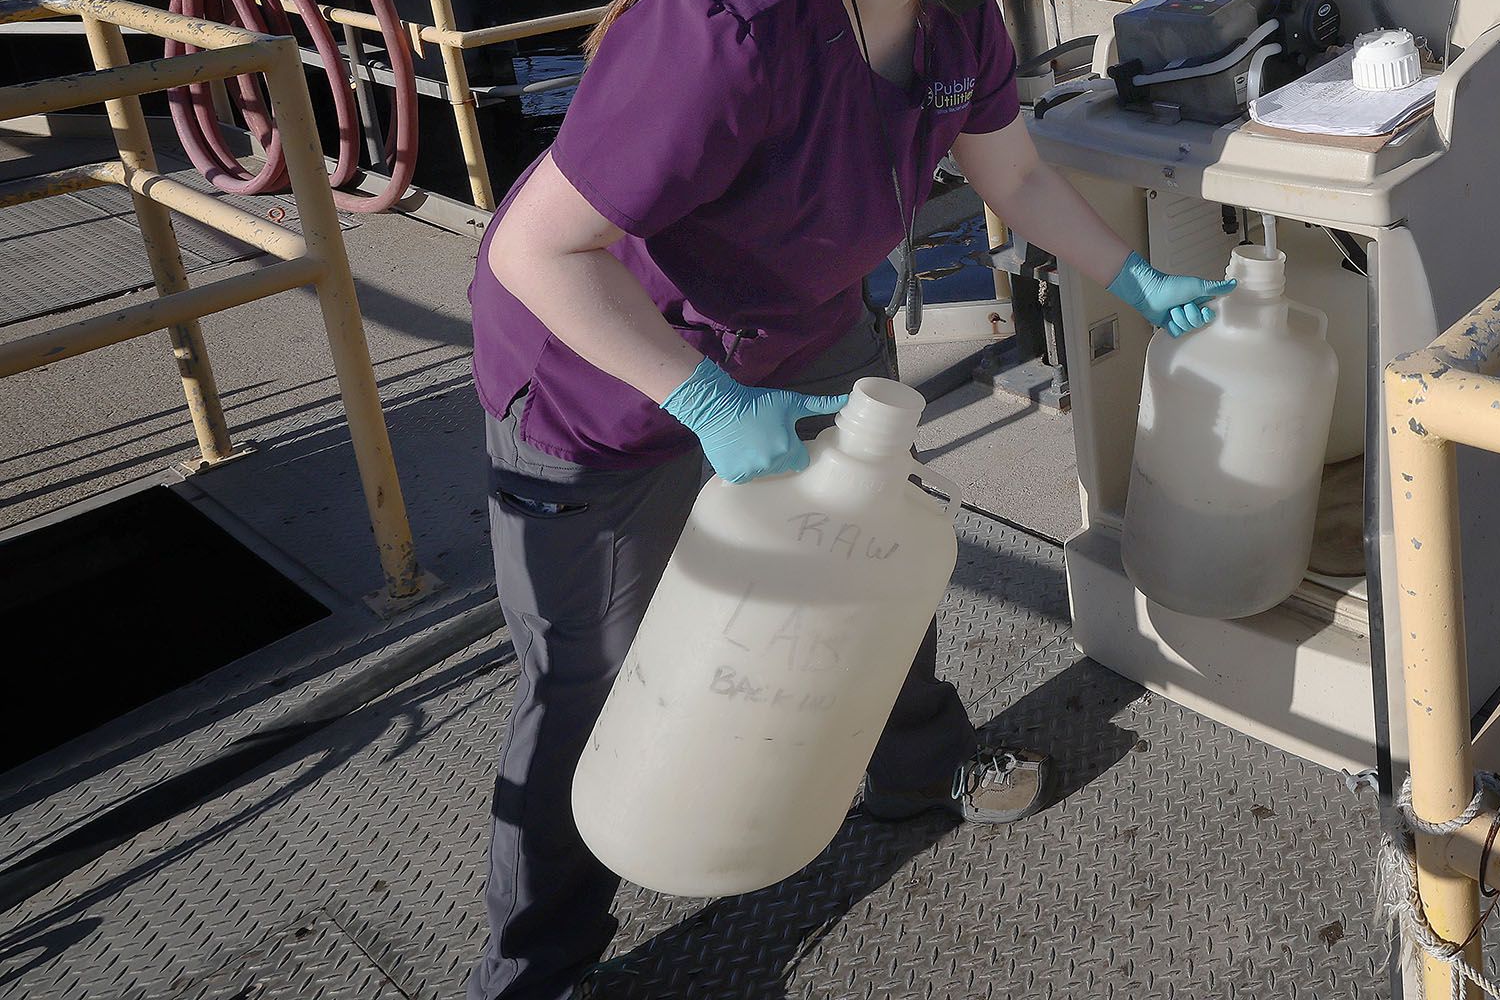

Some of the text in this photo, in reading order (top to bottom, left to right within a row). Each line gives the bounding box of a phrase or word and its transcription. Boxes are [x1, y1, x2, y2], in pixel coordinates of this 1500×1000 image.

[934, 76, 976, 96] Public
[934, 89, 974, 108] Utilitie
[787, 511, 900, 561] RAW
